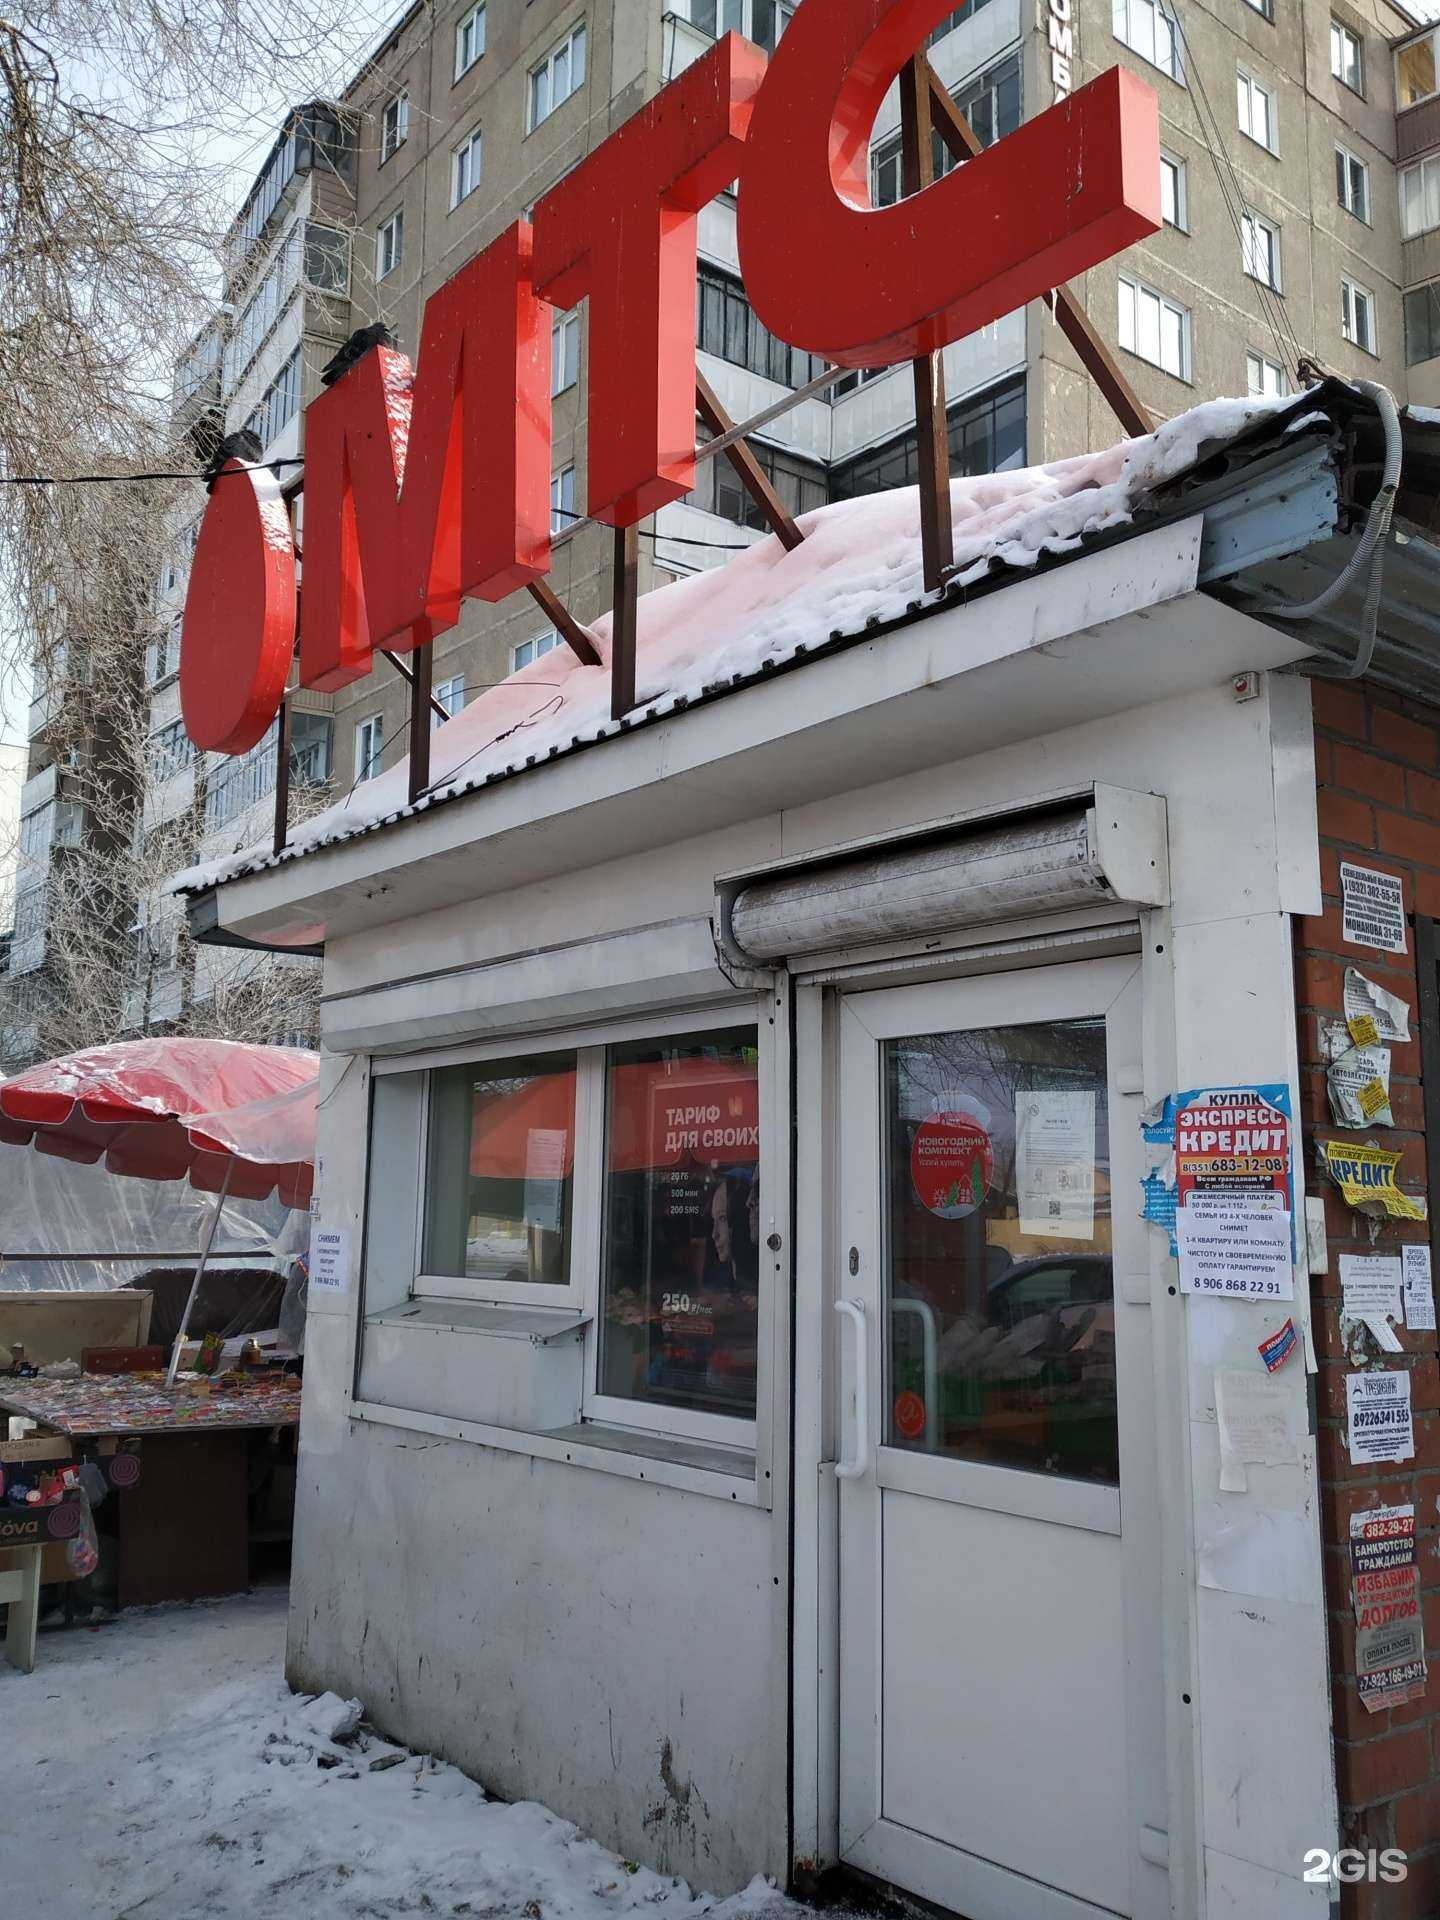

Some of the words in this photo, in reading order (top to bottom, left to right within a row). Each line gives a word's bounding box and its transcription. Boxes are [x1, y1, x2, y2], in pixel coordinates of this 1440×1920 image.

[300, 0, 1161, 693] МТС
[665, 1104, 721, 1126] ТАРИФ
[1180, 1108, 1282, 1127] ЭКСПРЕСС
[664, 1130, 699, 1152] ДЛЯ
[702, 1126, 759, 1148] СВОИХ
[918, 1135, 985, 1147] НОВОГОДНИЙ
[1179, 1129, 1285, 1155] КРЕДИТ
[918, 1146, 972, 1155] КОМПЛЕКТ
[1330, 1159, 1394, 1188] КРЕДИТ
[671, 1189, 684, 1198] 500
[1192, 1193, 1245, 1201] ЕЖЕМЕСЯЧНЫЙ
[670, 1205, 684, 1215] 200
[684, 1206, 700, 1215] SMS
[1194, 1211, 1218, 1219] СЕМЬЯ
[1240, 1213, 1274, 1221] ЧЕЛОВЕК
[1219, 1224, 1249, 1232] СНИМЕТ
[1197, 1237, 1232, 1245] КВАРТИРУ
[1187, 1249, 1217, 1258] ЧИСТОТУ
[1225, 1251, 1287, 1262] СВОЕВРЕМЕННУЮ
[1197, 1261, 1226, 1270] ОПЛАТУ
[1226, 1263, 1276, 1273] ГАРАНТИРУЕМ
[1193, 1277, 1201, 1288] 8
[1203, 1278, 1223, 1289] 906
[1225, 1279, 1247, 1291] 868
[1249, 1281, 1264, 1293] 22
[1266, 1282, 1281, 1294] 91
[662, 1292, 690, 1312] 250
[1366, 1518, 1415, 1538] 382-29-27
[1355, 1537, 1414, 1557] БАНКРОТСТВО
[1358, 1551, 1413, 1571] ГРАЖДАНАМ
[1356, 1569, 1417, 1594] ИЗБАВИМ
[1359, 1600, 1418, 1630] ДОЛГОВ
